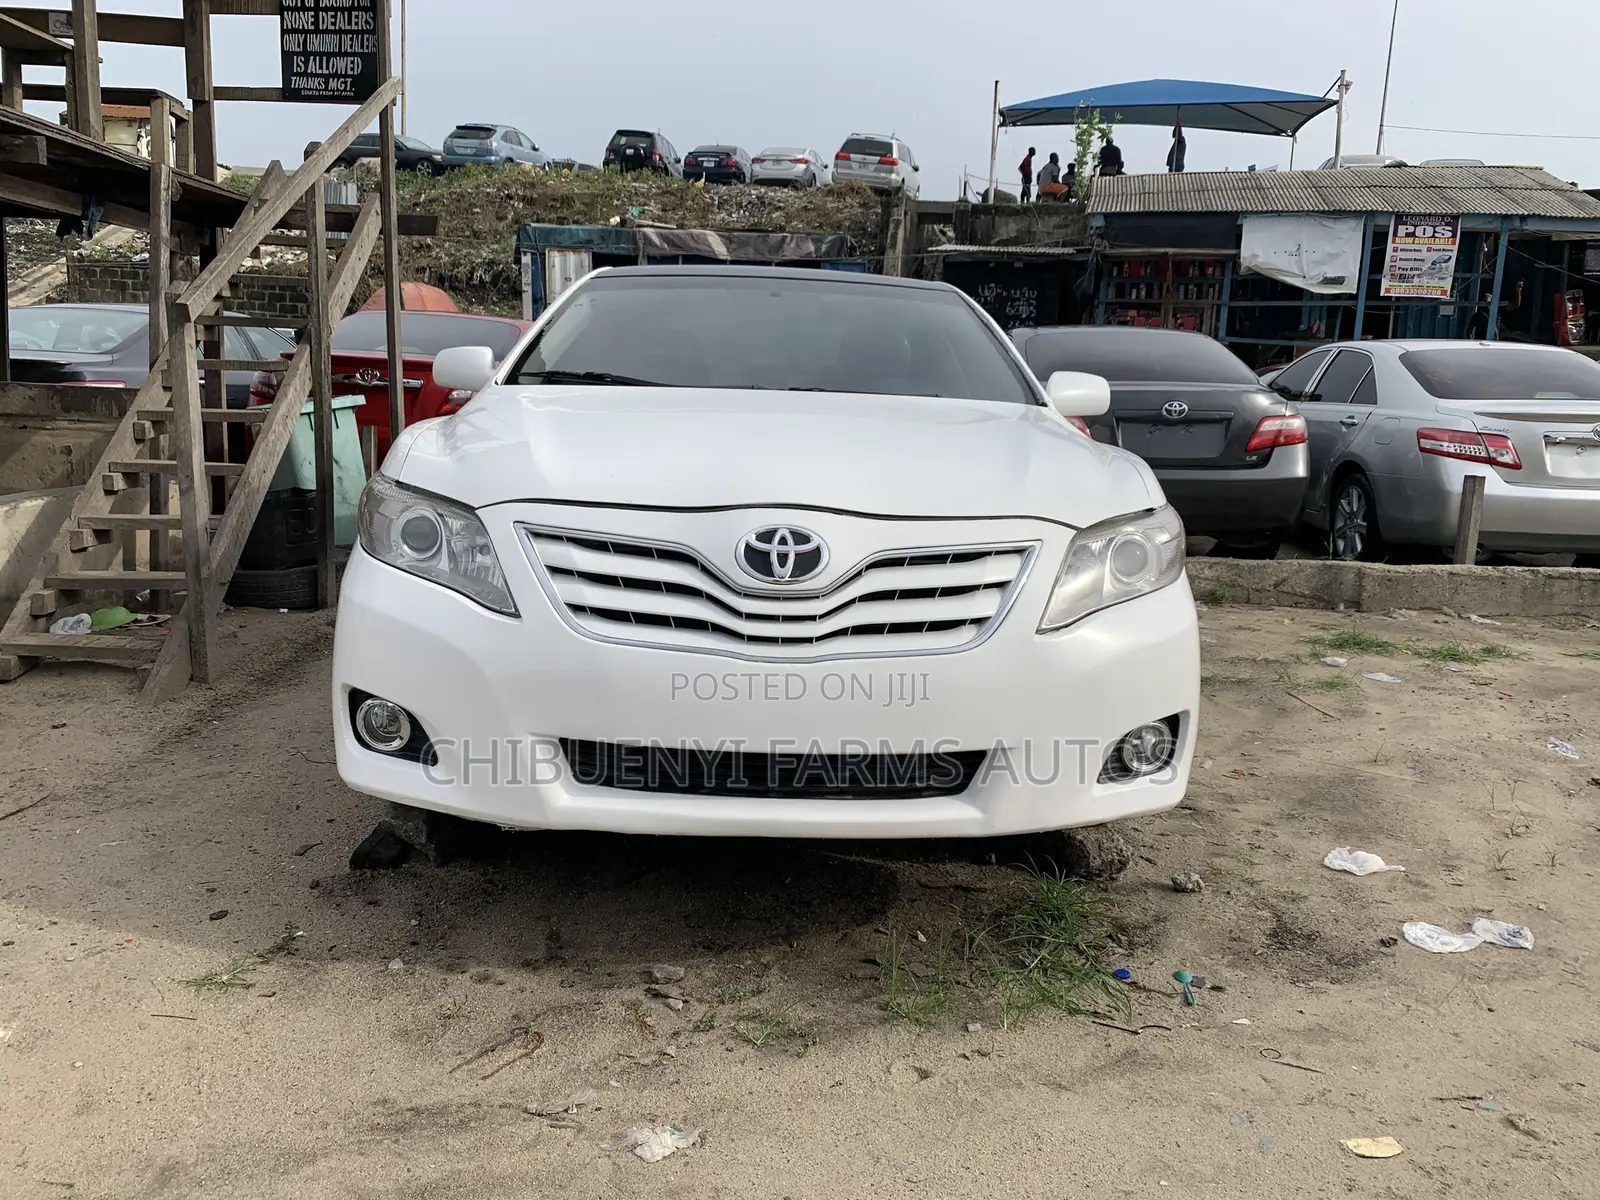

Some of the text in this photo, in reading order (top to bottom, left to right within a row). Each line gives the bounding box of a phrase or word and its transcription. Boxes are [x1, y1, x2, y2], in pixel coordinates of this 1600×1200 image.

[283, 11, 374, 30] NONE DEALERS
[283, 33, 305, 52] ONLY
[341, 34, 378, 53] DEALERS
[293, 55, 362, 75] IS ALLOWED
[290, 76, 355, 91] THANKS MGT.
[1397, 225, 1453, 238] POS
